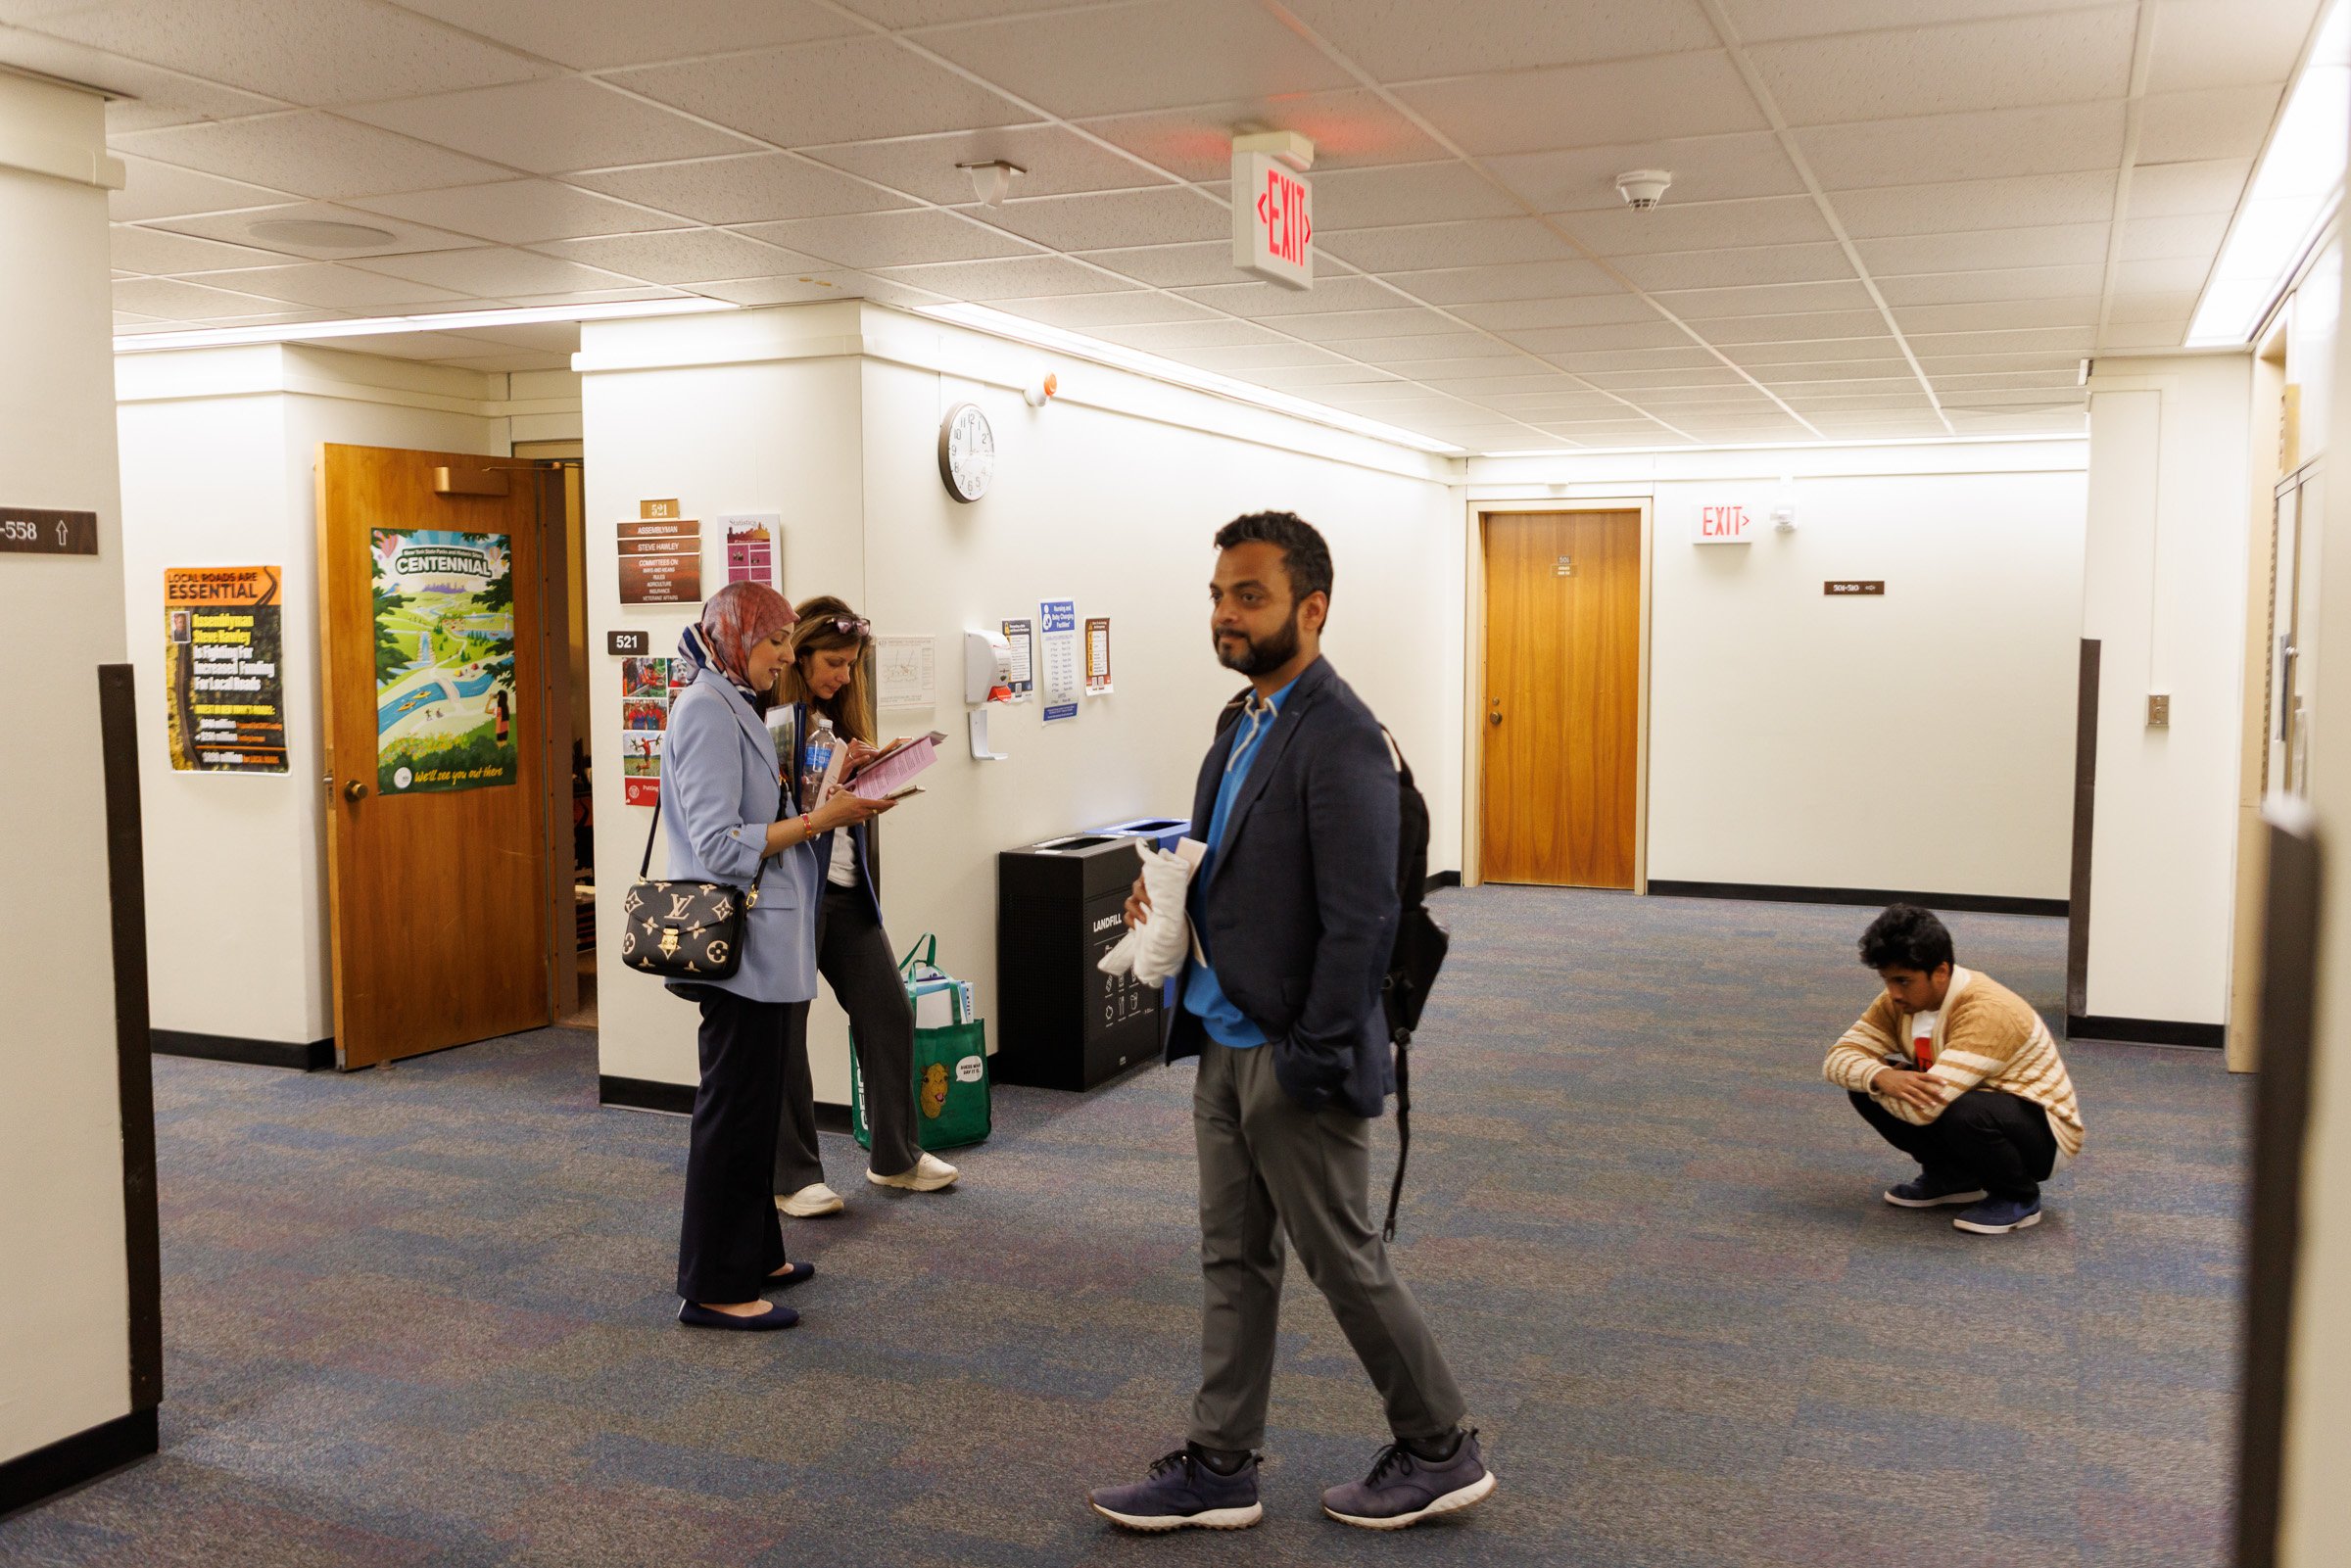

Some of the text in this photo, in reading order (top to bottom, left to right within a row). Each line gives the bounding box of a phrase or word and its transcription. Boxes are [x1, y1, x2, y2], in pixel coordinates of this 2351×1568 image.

[1268, 168, 1305, 267] EXIT
[650, 503, 668, 517] 521
[1702, 506, 1743, 537] EXIT
[637, 525, 679, 535] ASSEMBLYMAN
[638, 542, 680, 551] STEVE HAWLEY
[396, 555, 492, 576] CENTENNIAL
[168, 572, 258, 583] LOCAL ROADS ARE
[168, 583, 259, 599] ESSENTIAL
[616, 636, 638, 648] 521
[414, 769, 438, 783] We'll
[438, 771, 451, 781] see
[452, 771, 466, 785] you
[468, 767, 483, 779] out
[483, 764, 504, 778] there
[1093, 913, 1123, 933] LANDFILL
